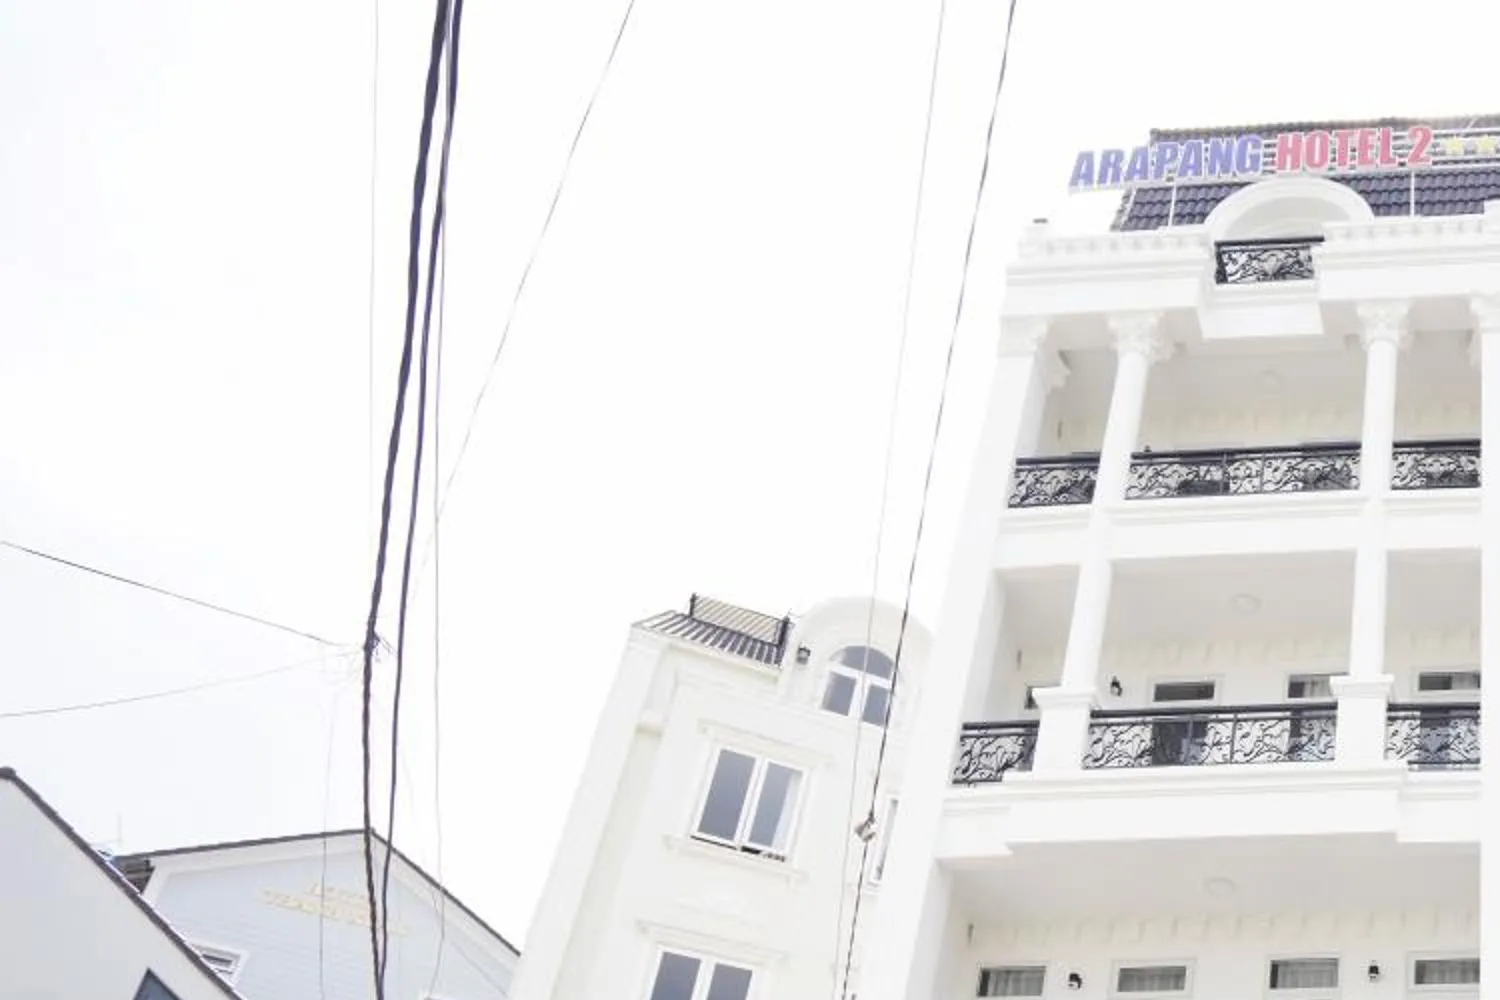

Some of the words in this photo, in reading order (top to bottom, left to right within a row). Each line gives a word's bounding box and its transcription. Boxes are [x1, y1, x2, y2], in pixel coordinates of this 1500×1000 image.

[1068, 134, 1263, 190] ARAPANG
[1275, 127, 1398, 174] HOTEL
[1405, 125, 1434, 168] 2
